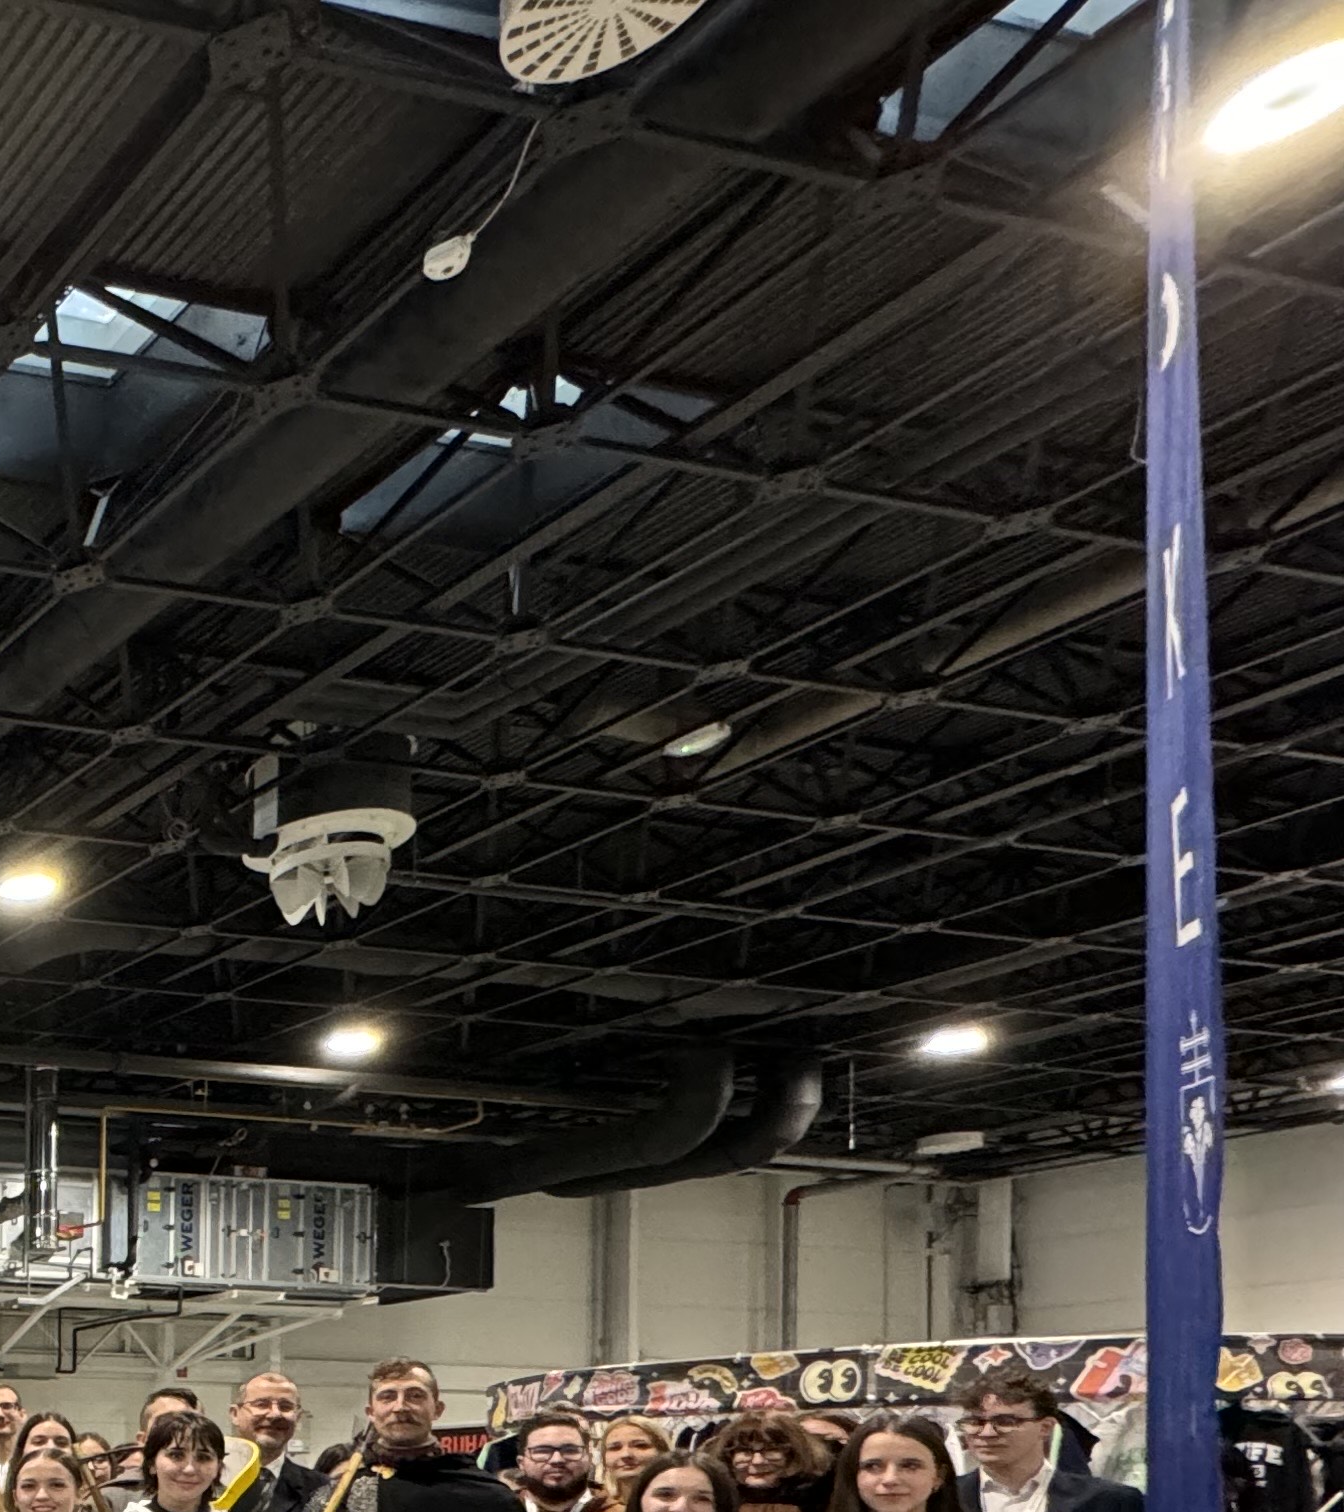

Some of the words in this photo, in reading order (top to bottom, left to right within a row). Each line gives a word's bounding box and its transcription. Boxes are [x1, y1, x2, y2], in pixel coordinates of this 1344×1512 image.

[180, 1182, 194, 1252] WEGER
[909, 1353, 950, 1370] COOL
[903, 1365, 941, 1384] COOL
